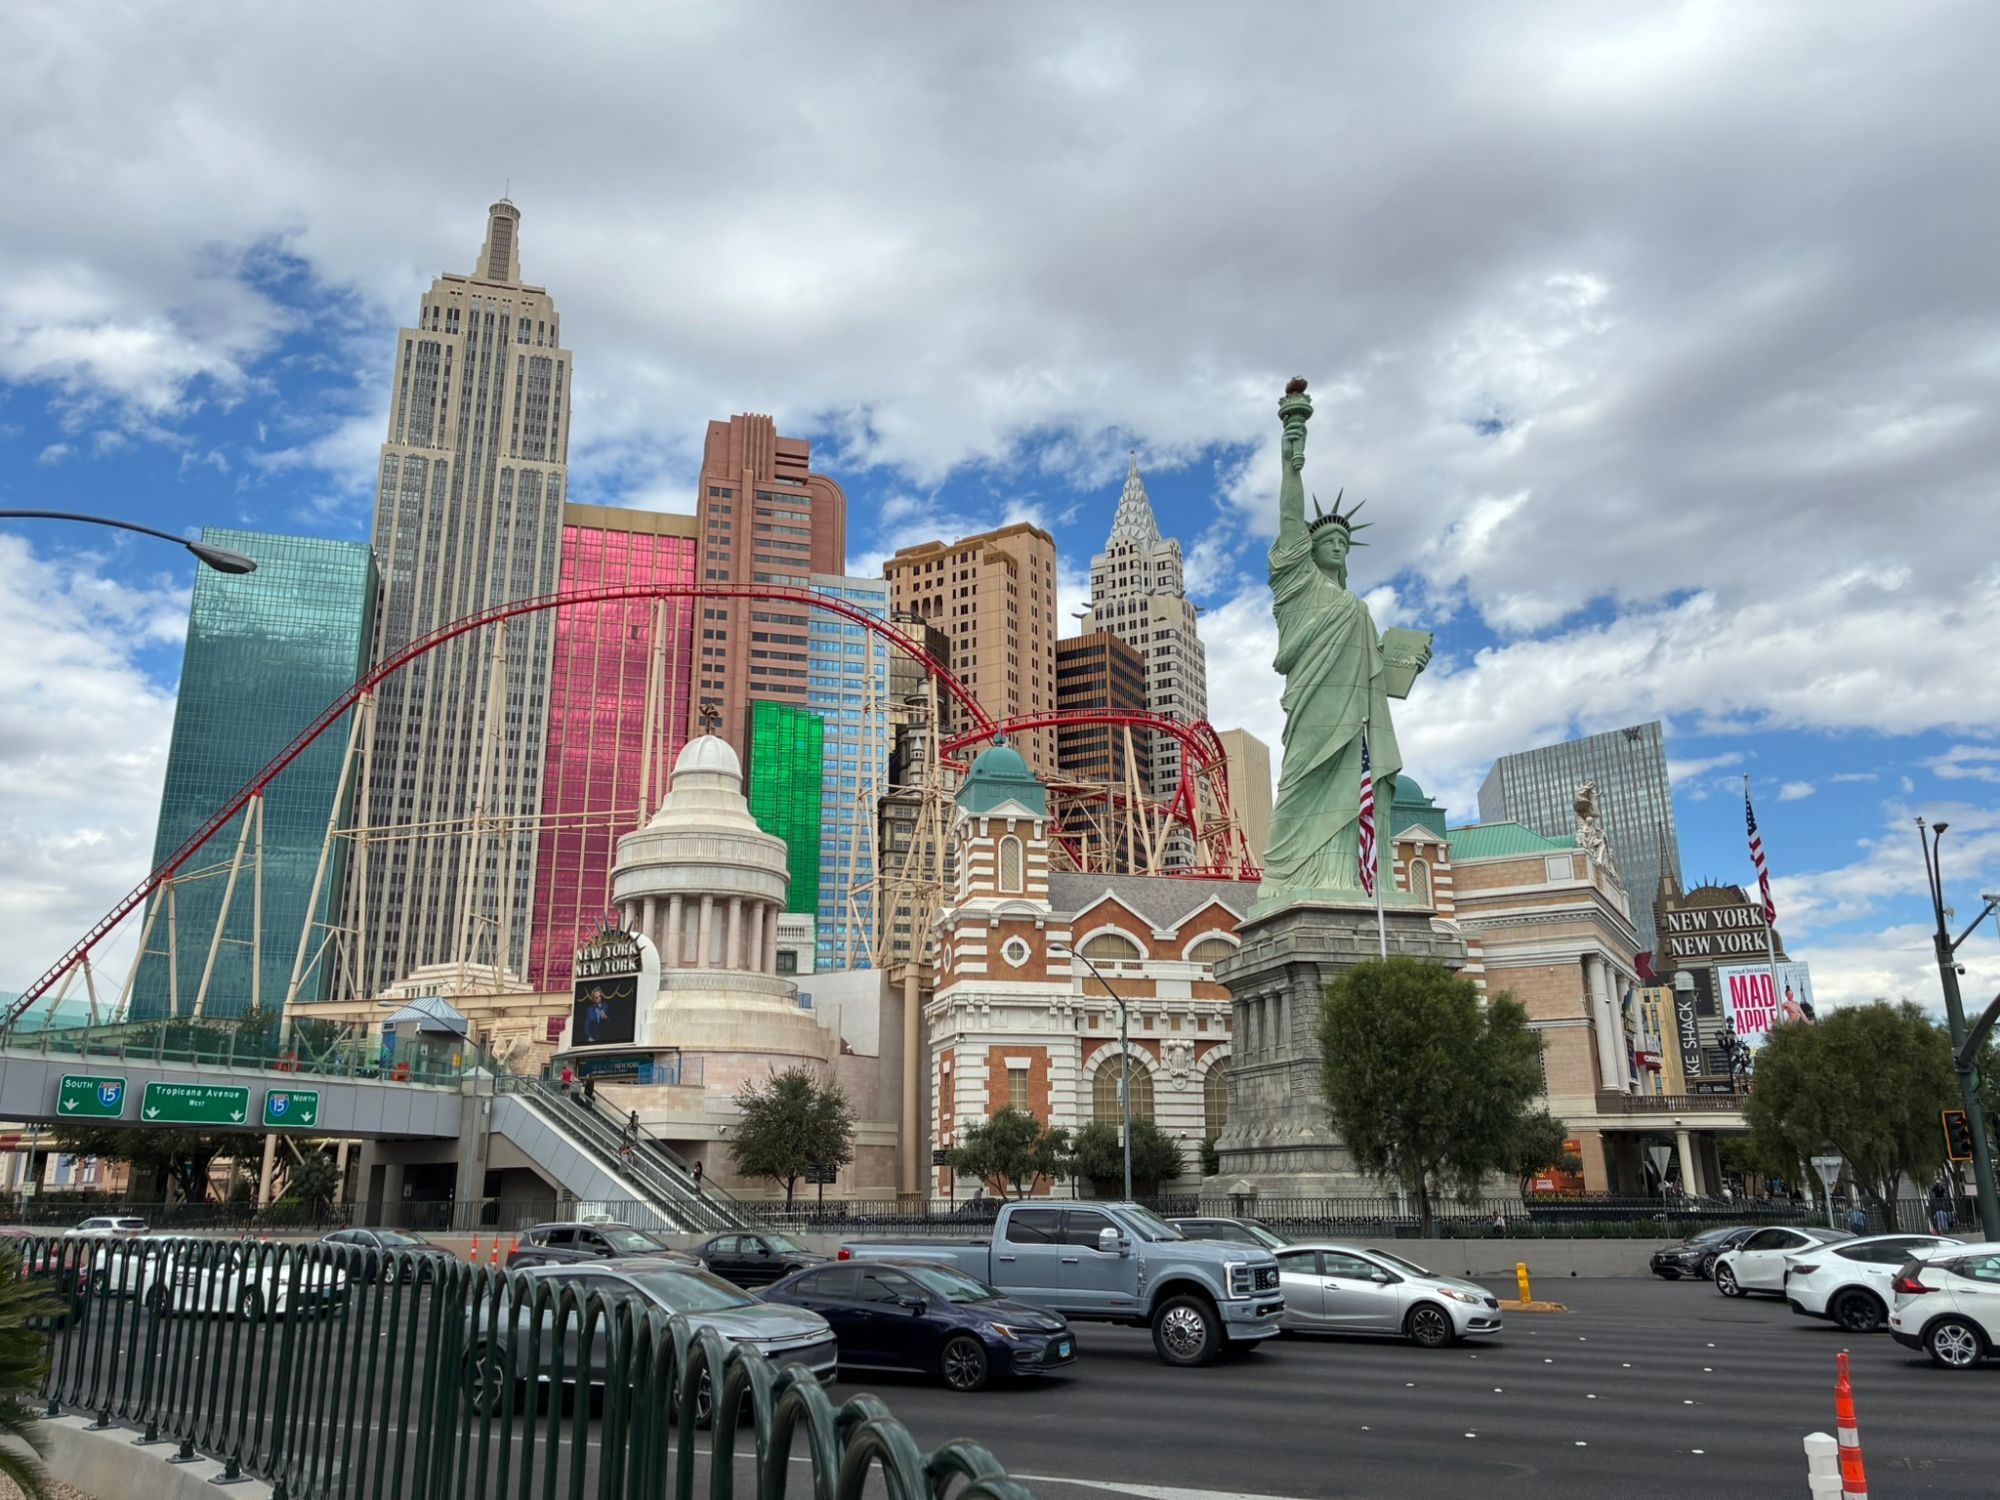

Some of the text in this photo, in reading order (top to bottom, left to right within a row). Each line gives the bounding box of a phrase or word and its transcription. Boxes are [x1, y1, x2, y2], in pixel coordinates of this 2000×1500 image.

[1667, 907, 1764, 932] NEW YORK
[577, 943, 638, 960] NEW YORK
[1671, 931, 1768, 956] NEW YORK
[576, 959, 637, 976] NEW YORK
[1729, 973, 1775, 1009] MAD
[1677, 1001, 1701, 1077] KE SHACK
[64, 1079, 93, 1088] SOUTH
[156, 1086, 240, 1098] Tropicana Avenue
[103, 1088, 116, 1102] 15
[293, 1094, 316, 1102] NORTH
[273, 1099, 285, 1112] 15
